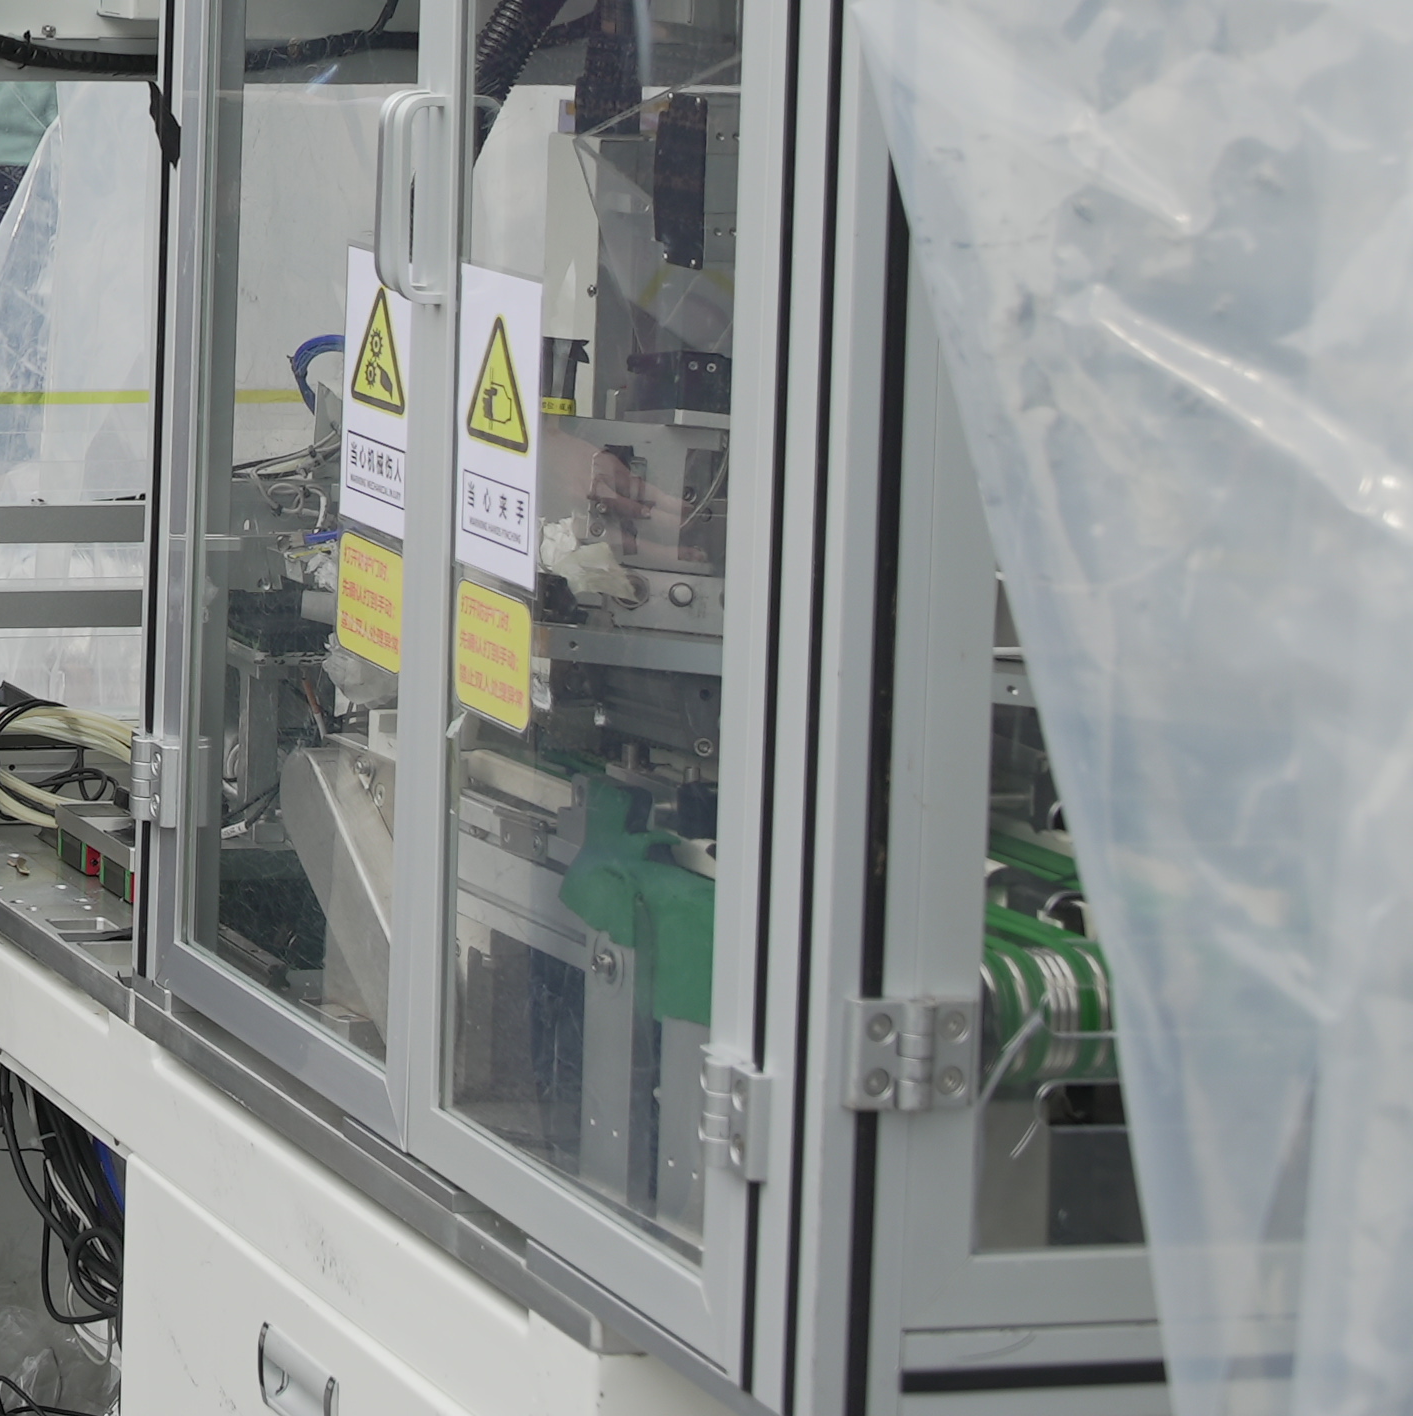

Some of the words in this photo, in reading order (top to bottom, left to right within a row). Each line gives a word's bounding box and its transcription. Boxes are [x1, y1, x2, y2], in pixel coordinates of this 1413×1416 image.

[350, 441, 402, 483] 当心机械伤人
[467, 481, 524, 526] 当心夹手
